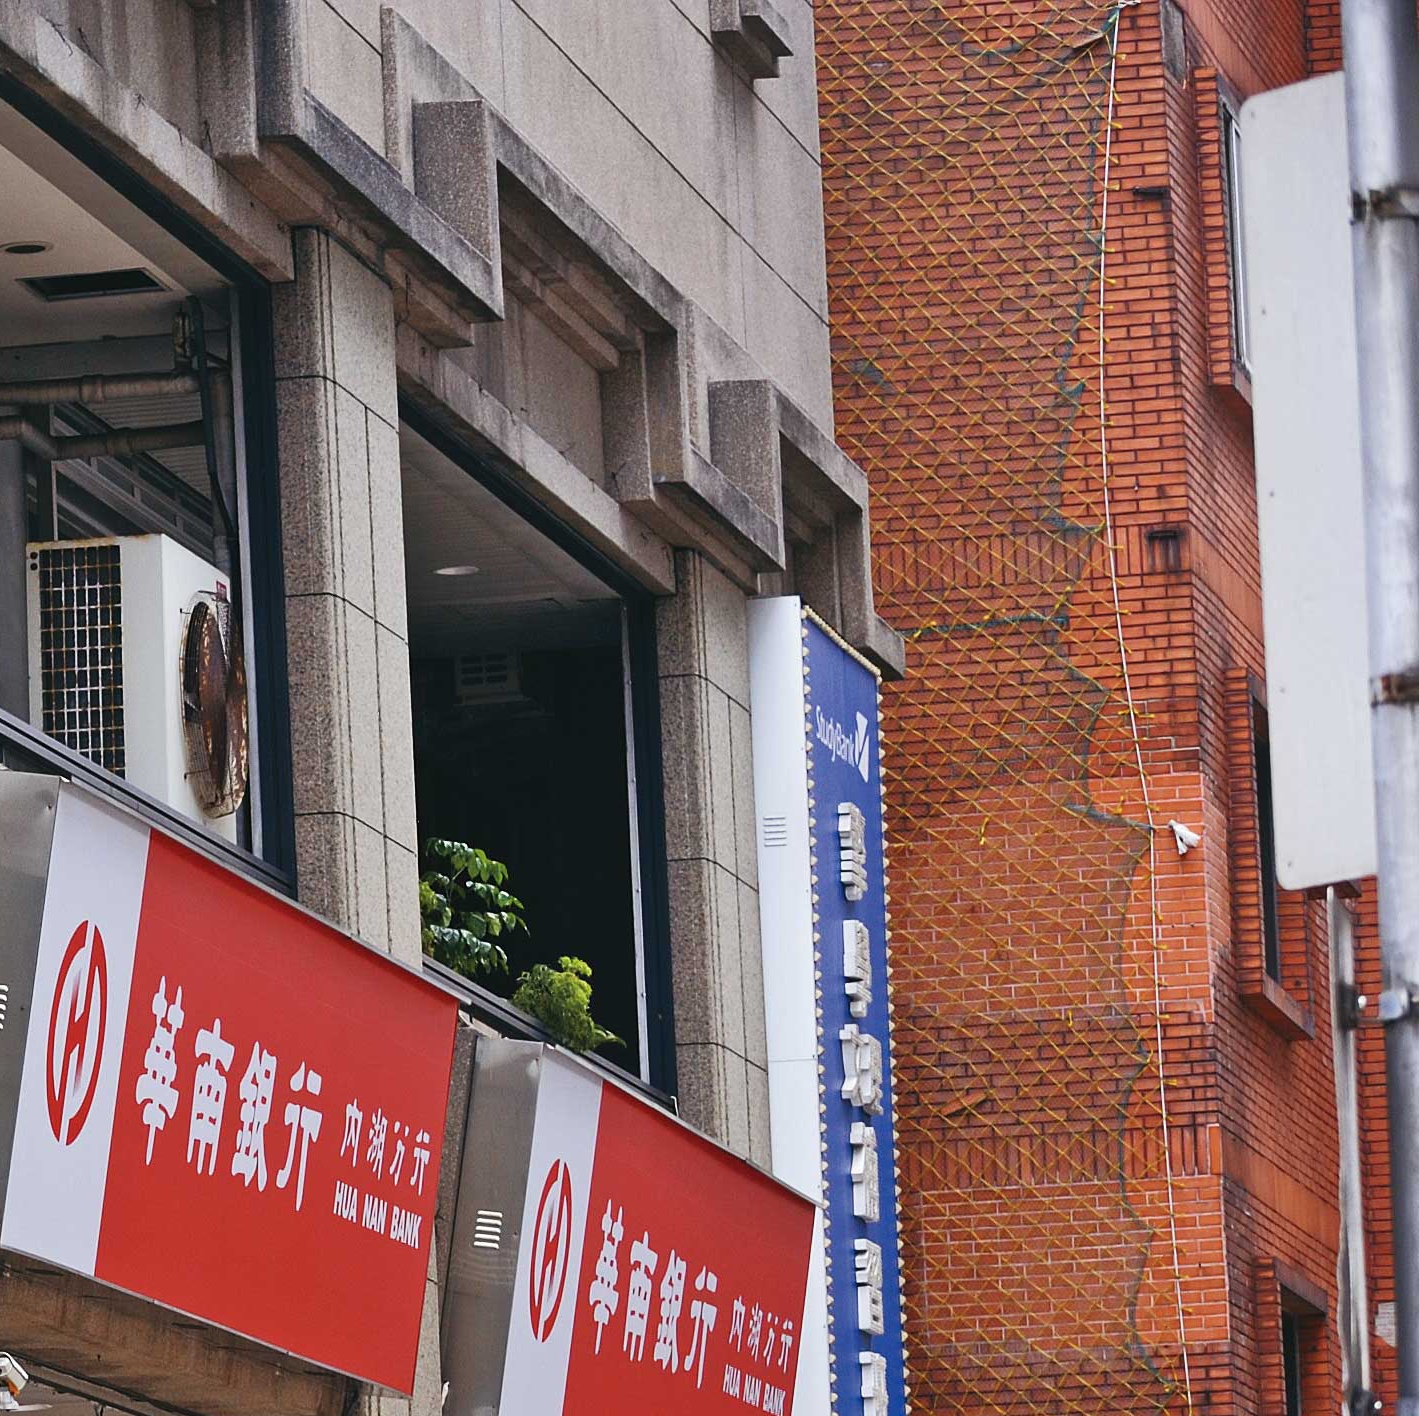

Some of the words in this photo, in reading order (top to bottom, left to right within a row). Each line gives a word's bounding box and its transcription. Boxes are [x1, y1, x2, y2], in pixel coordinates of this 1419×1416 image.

[815, 703, 857, 768] StudyBank
[135, 976, 323, 1212] 華南銀行
[333, 1180, 359, 1224] HUA
[361, 1193, 388, 1235] NAN
[390, 1205, 422, 1250] BANK
[588, 1199, 719, 1389] 華南銀行
[722, 1363, 741, 1399] HUA
[743, 1374, 762, 1408] NAN
